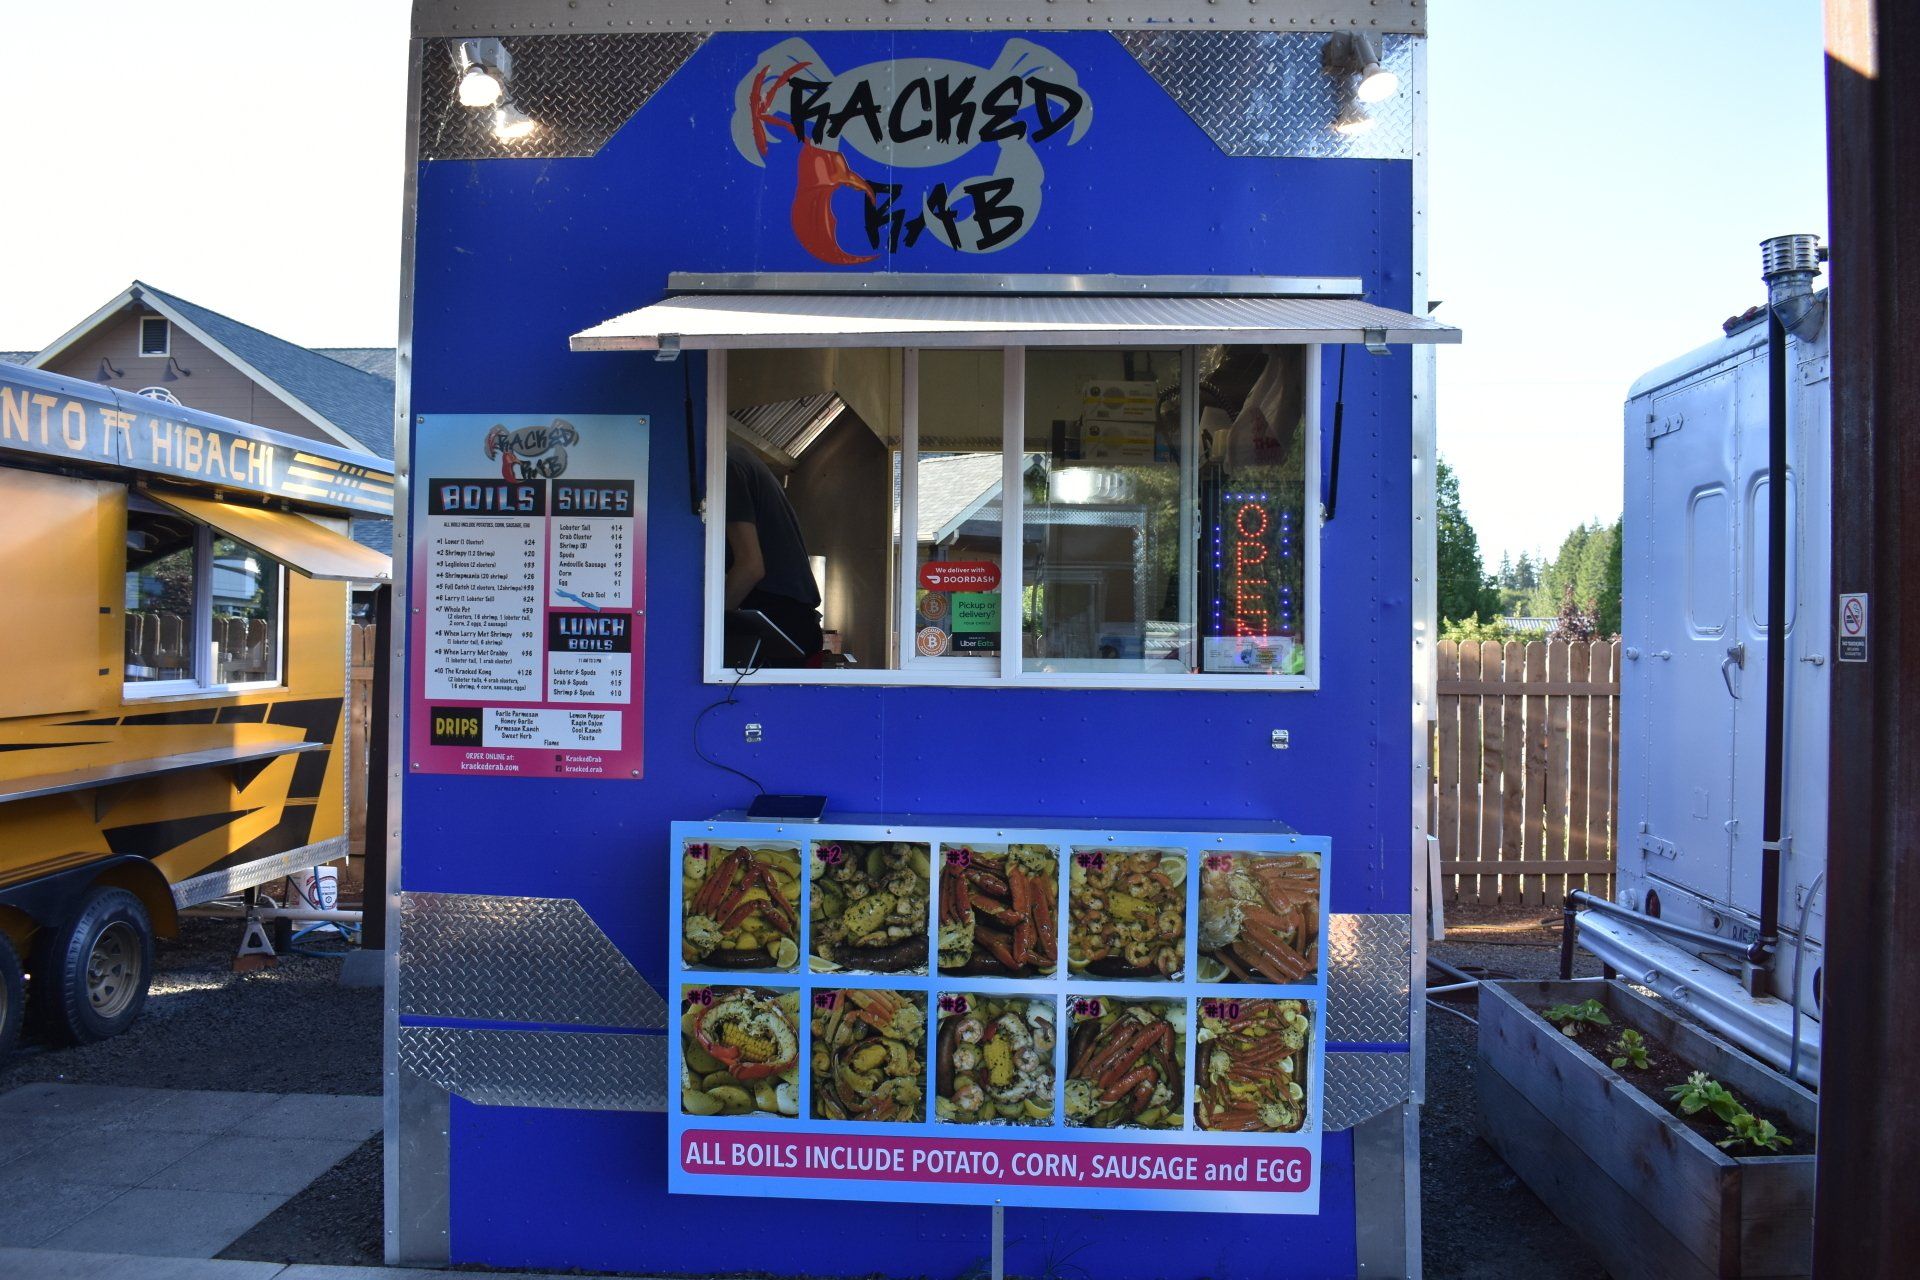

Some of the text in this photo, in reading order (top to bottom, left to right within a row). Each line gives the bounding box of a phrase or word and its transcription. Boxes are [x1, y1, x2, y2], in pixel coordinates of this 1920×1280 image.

[750, 61, 1083, 155] KRACKED
[150, 419, 274, 487] HIBACHI
[441, 485, 535, 511] BOILS
[558, 487, 628, 511] SIDES
[1237, 503, 1268, 647] OPEN
[959, 602, 985, 610] Pickup
[959, 610, 995, 619] delivery?
[560, 618, 624, 636] LUNCH
[569, 639, 613, 650] BOILS
[512, 710, 538, 718] Parmesan
[436, 718, 478, 737] DRIPS
[461, 762, 518, 771] krackedcrab.com
[689, 843, 710, 860] #1
[816, 845, 841, 863] #2
[947, 850, 971, 866] #3
[1077, 853, 1104, 869] #4
[1208, 855, 1233, 871] #5
[689, 990, 712, 1005] #6
[815, 993, 836, 1009] #7
[940, 996, 966, 1013] #8
[1075, 1000, 1100, 1017] #9
[1204, 1002, 1239, 1019] #10
[686, 1142, 1302, 1184] ALL BOILS INCLUDE POTATO, CORN, SAUSAGE and EGG
